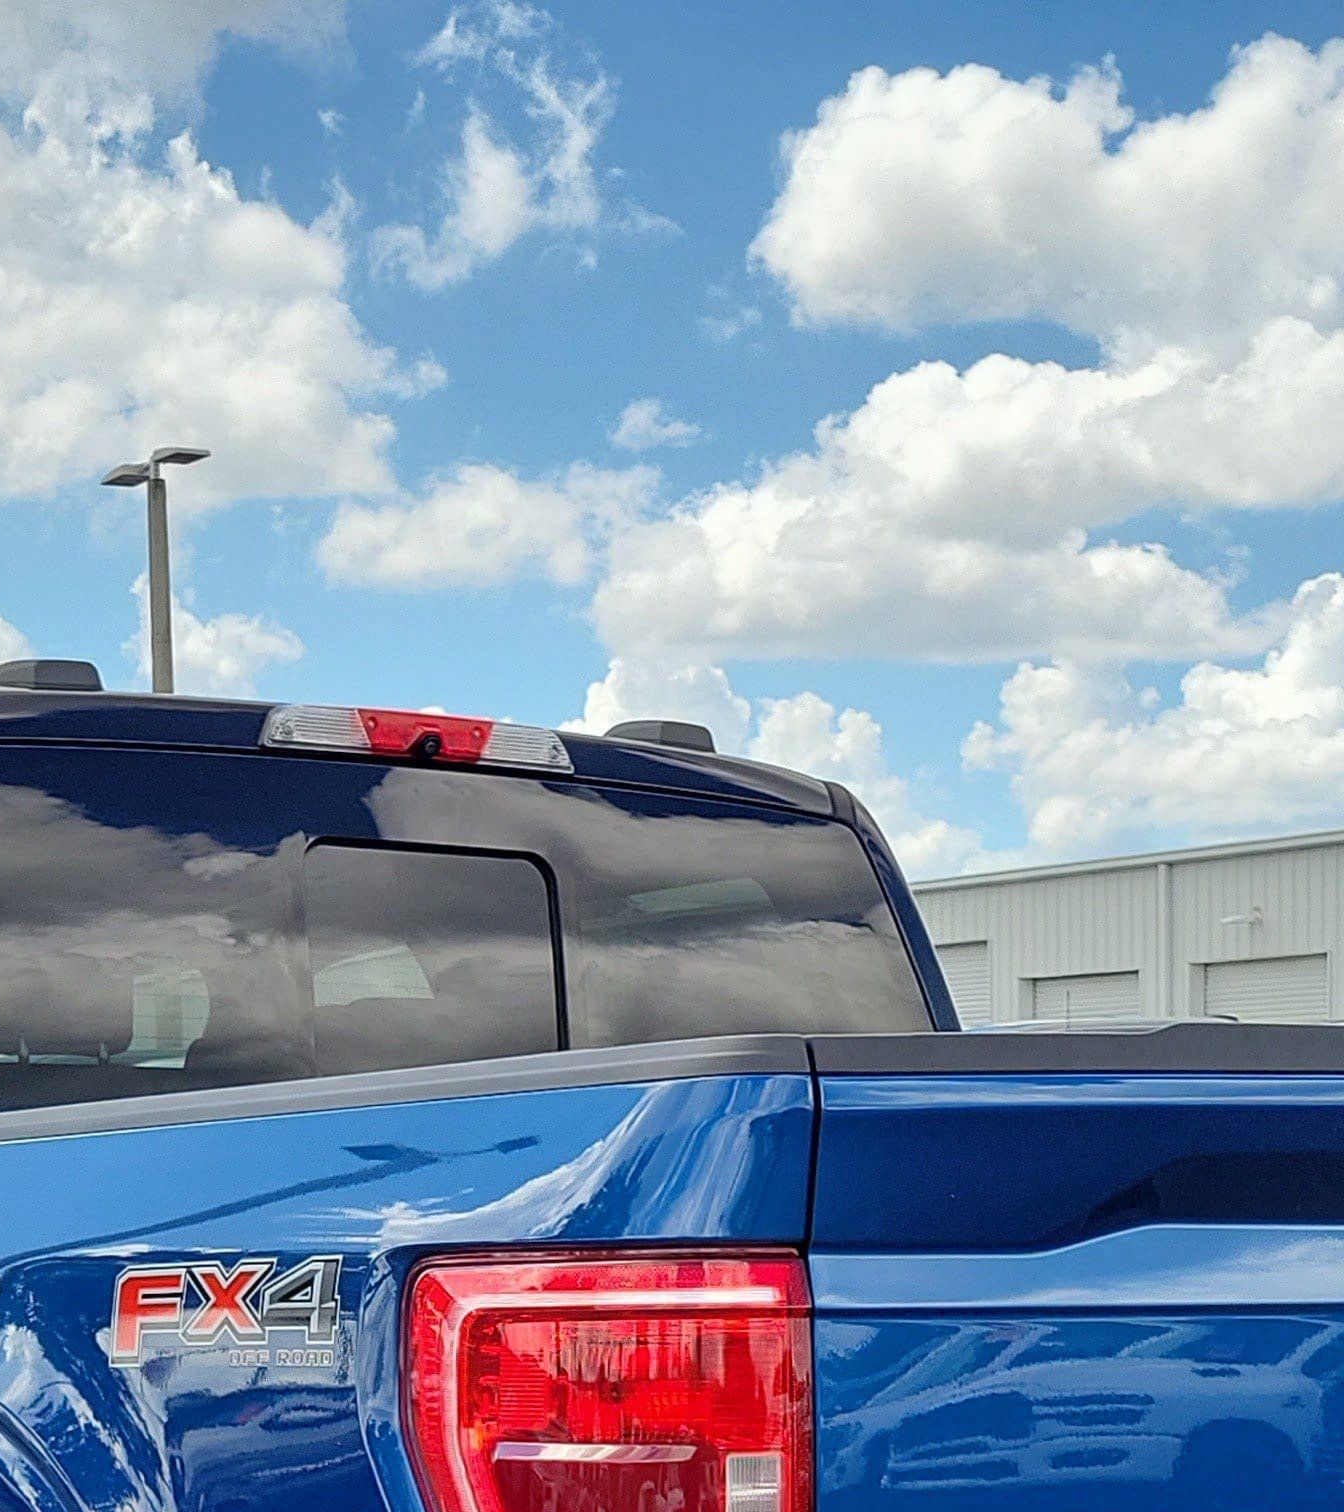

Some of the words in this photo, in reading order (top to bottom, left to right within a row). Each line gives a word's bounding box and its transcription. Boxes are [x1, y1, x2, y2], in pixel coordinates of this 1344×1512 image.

[109, 1254, 344, 1368] FX4
[229, 1349, 271, 1367] OFF
[277, 1349, 335, 1367] ROAD
